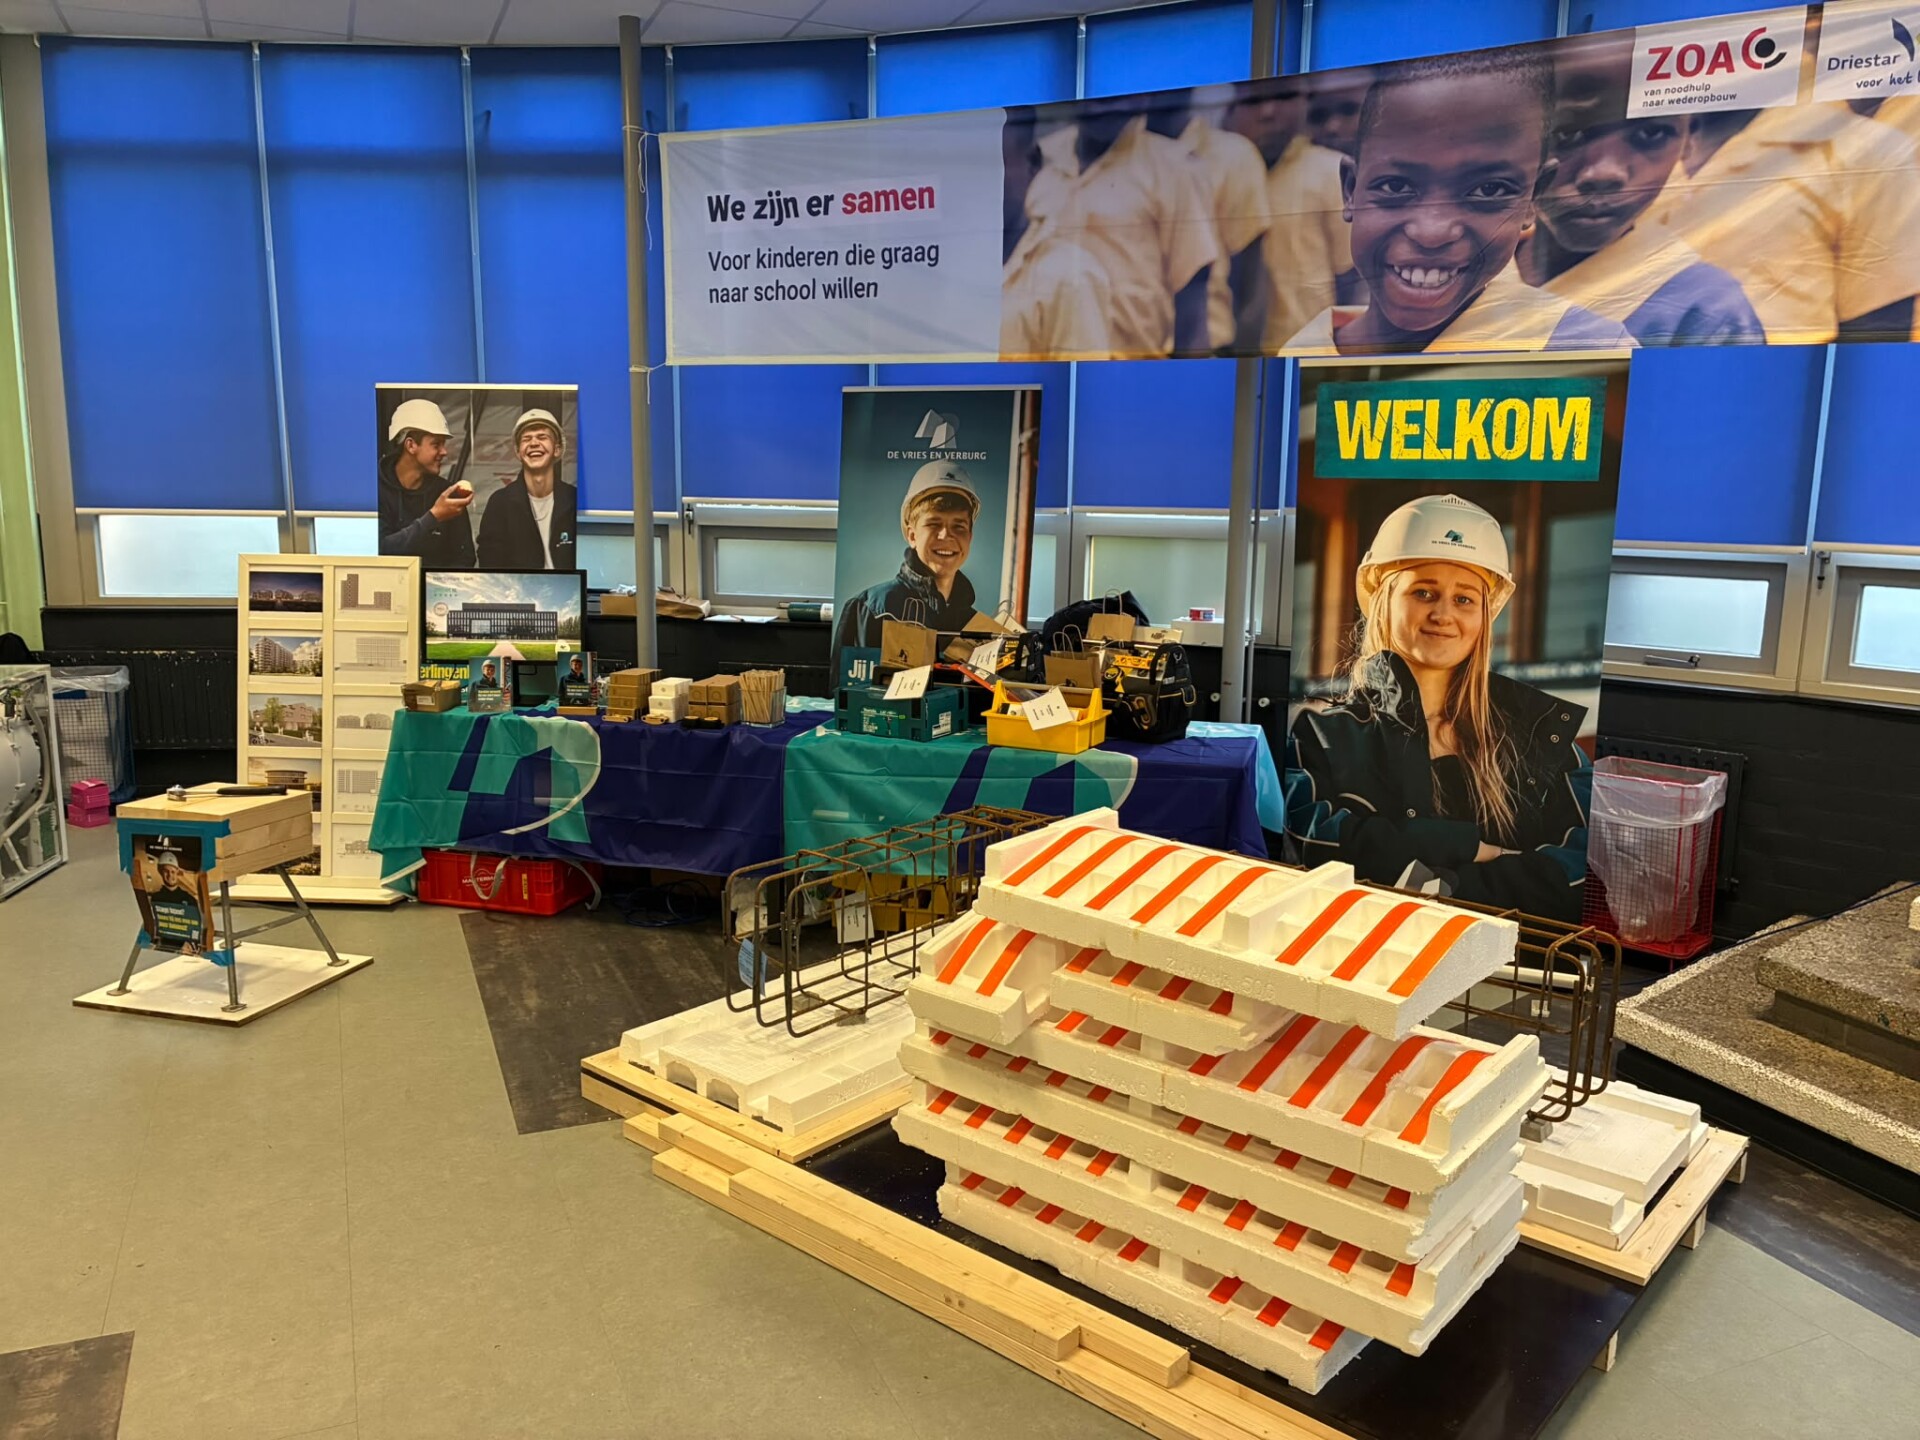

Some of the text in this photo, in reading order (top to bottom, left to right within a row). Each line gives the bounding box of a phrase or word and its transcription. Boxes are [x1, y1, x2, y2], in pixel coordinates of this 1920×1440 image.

[1646, 41, 1735, 81] ZOA
[1827, 54, 1900, 71] Driestar
[1644, 82, 1711, 97] van noodhulp
[1856, 79, 1883, 89] voor
[1889, 71, 1913, 85] het
[1642, 92, 1737, 107] naar wederopbouw
[707, 185, 936, 226] We zijn er samen
[708, 243, 940, 271] Voor kinderen die graag
[709, 277, 879, 304] naar school willen
[1334, 397, 1592, 461] WELKOM
[887, 451, 987, 461] DE VRIES EN VERBURG
[420, 664, 470, 680] erlingen
[848, 659, 867, 682] Jij
